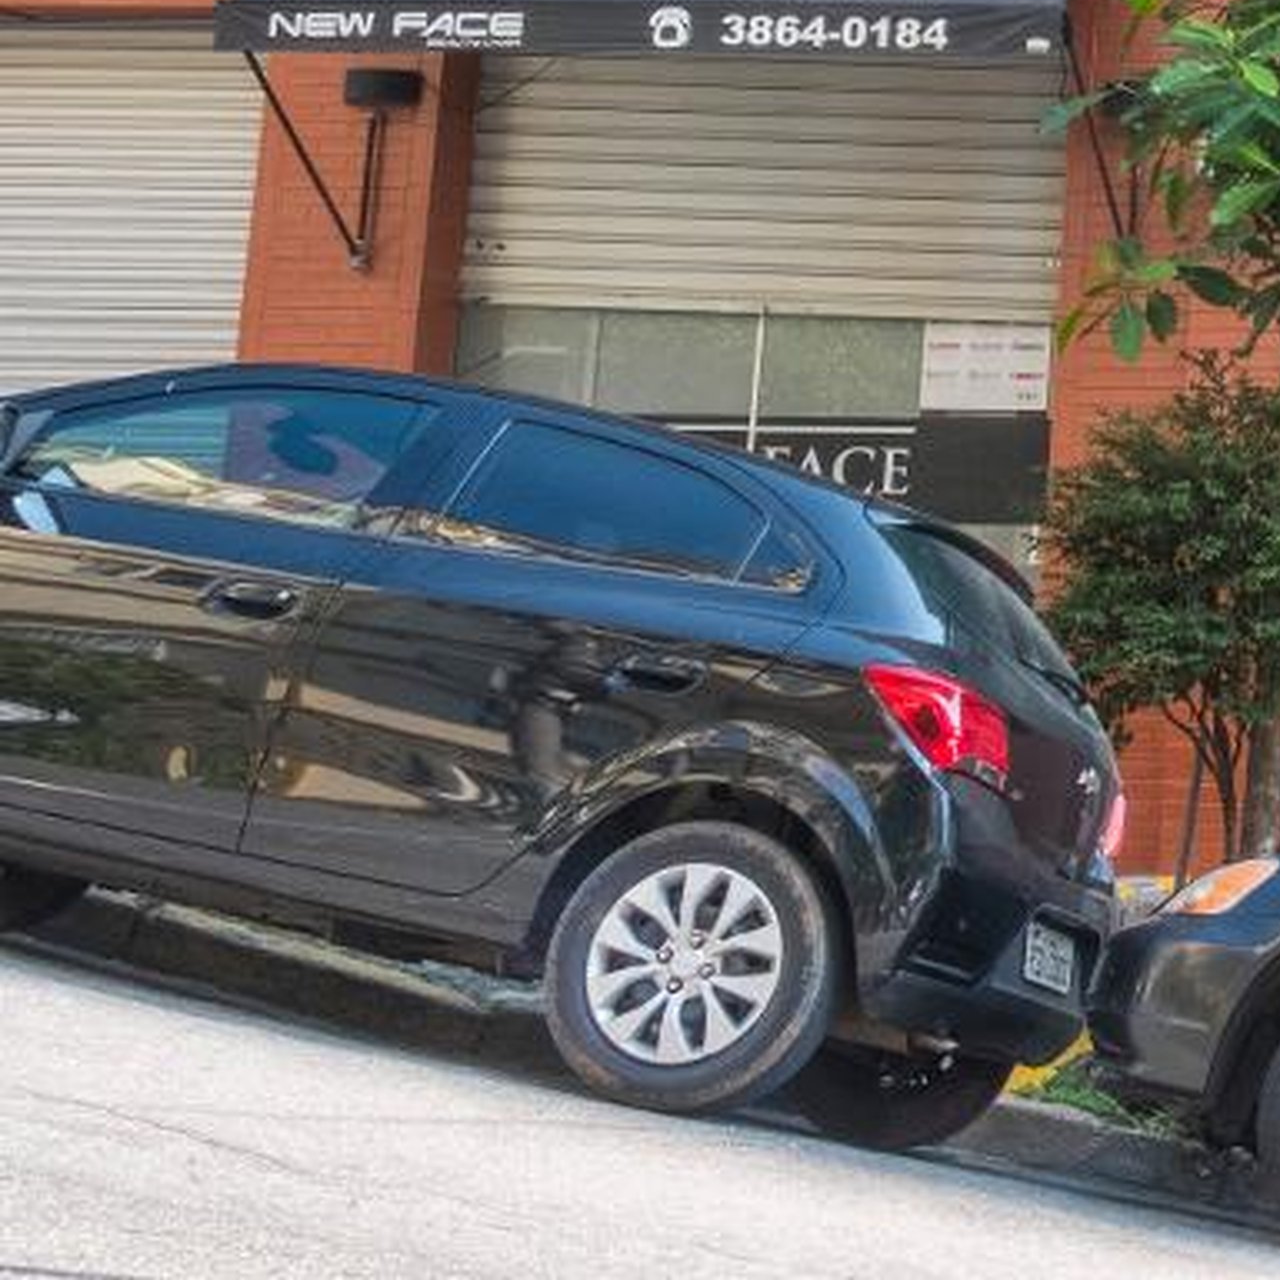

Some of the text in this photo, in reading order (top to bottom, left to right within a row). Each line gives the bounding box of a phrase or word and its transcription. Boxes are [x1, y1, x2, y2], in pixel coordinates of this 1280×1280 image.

[268, 11, 525, 38] NEW FACE
[719, 14, 949, 50] 3864-0184
[763, 445, 911, 496] ACE
